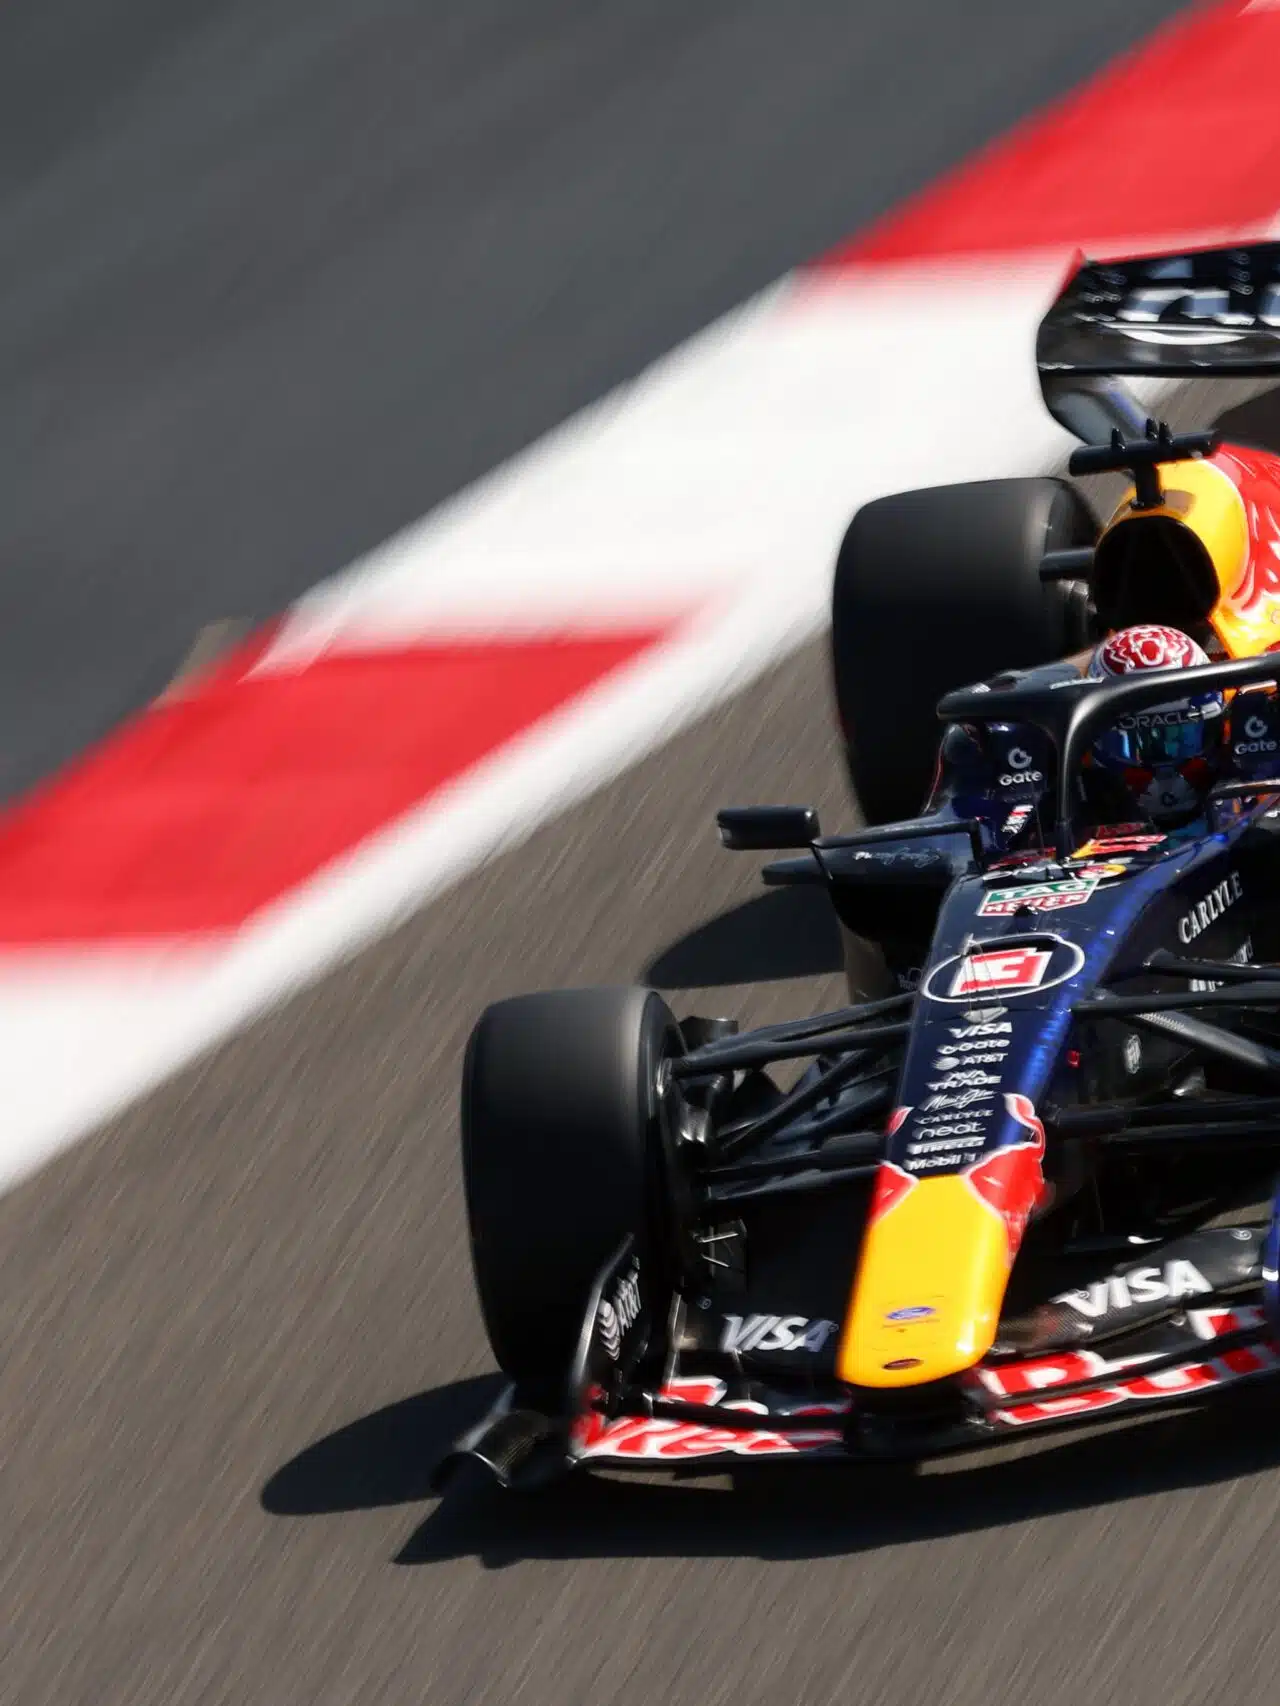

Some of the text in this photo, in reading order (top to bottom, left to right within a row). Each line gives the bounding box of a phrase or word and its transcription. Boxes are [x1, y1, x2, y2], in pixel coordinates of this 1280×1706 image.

[1234, 740, 1278, 756] Gate
[999, 769, 1043, 786] Gate
[998, 878, 1093, 901] TAG
[985, 894, 1087, 915] HEUER
[1178, 869, 1244, 944] CARLYLE
[947, 1021, 1013, 1039] VISA
[961, 1053, 1009, 1066] AT&T
[925, 1075, 1002, 1092] TRADE
[912, 1121, 987, 1141] neat
[905, 1152, 962, 1171] Mobil
[1048, 1259, 1214, 1317] VISA
[718, 1312, 837, 1353] VISA
